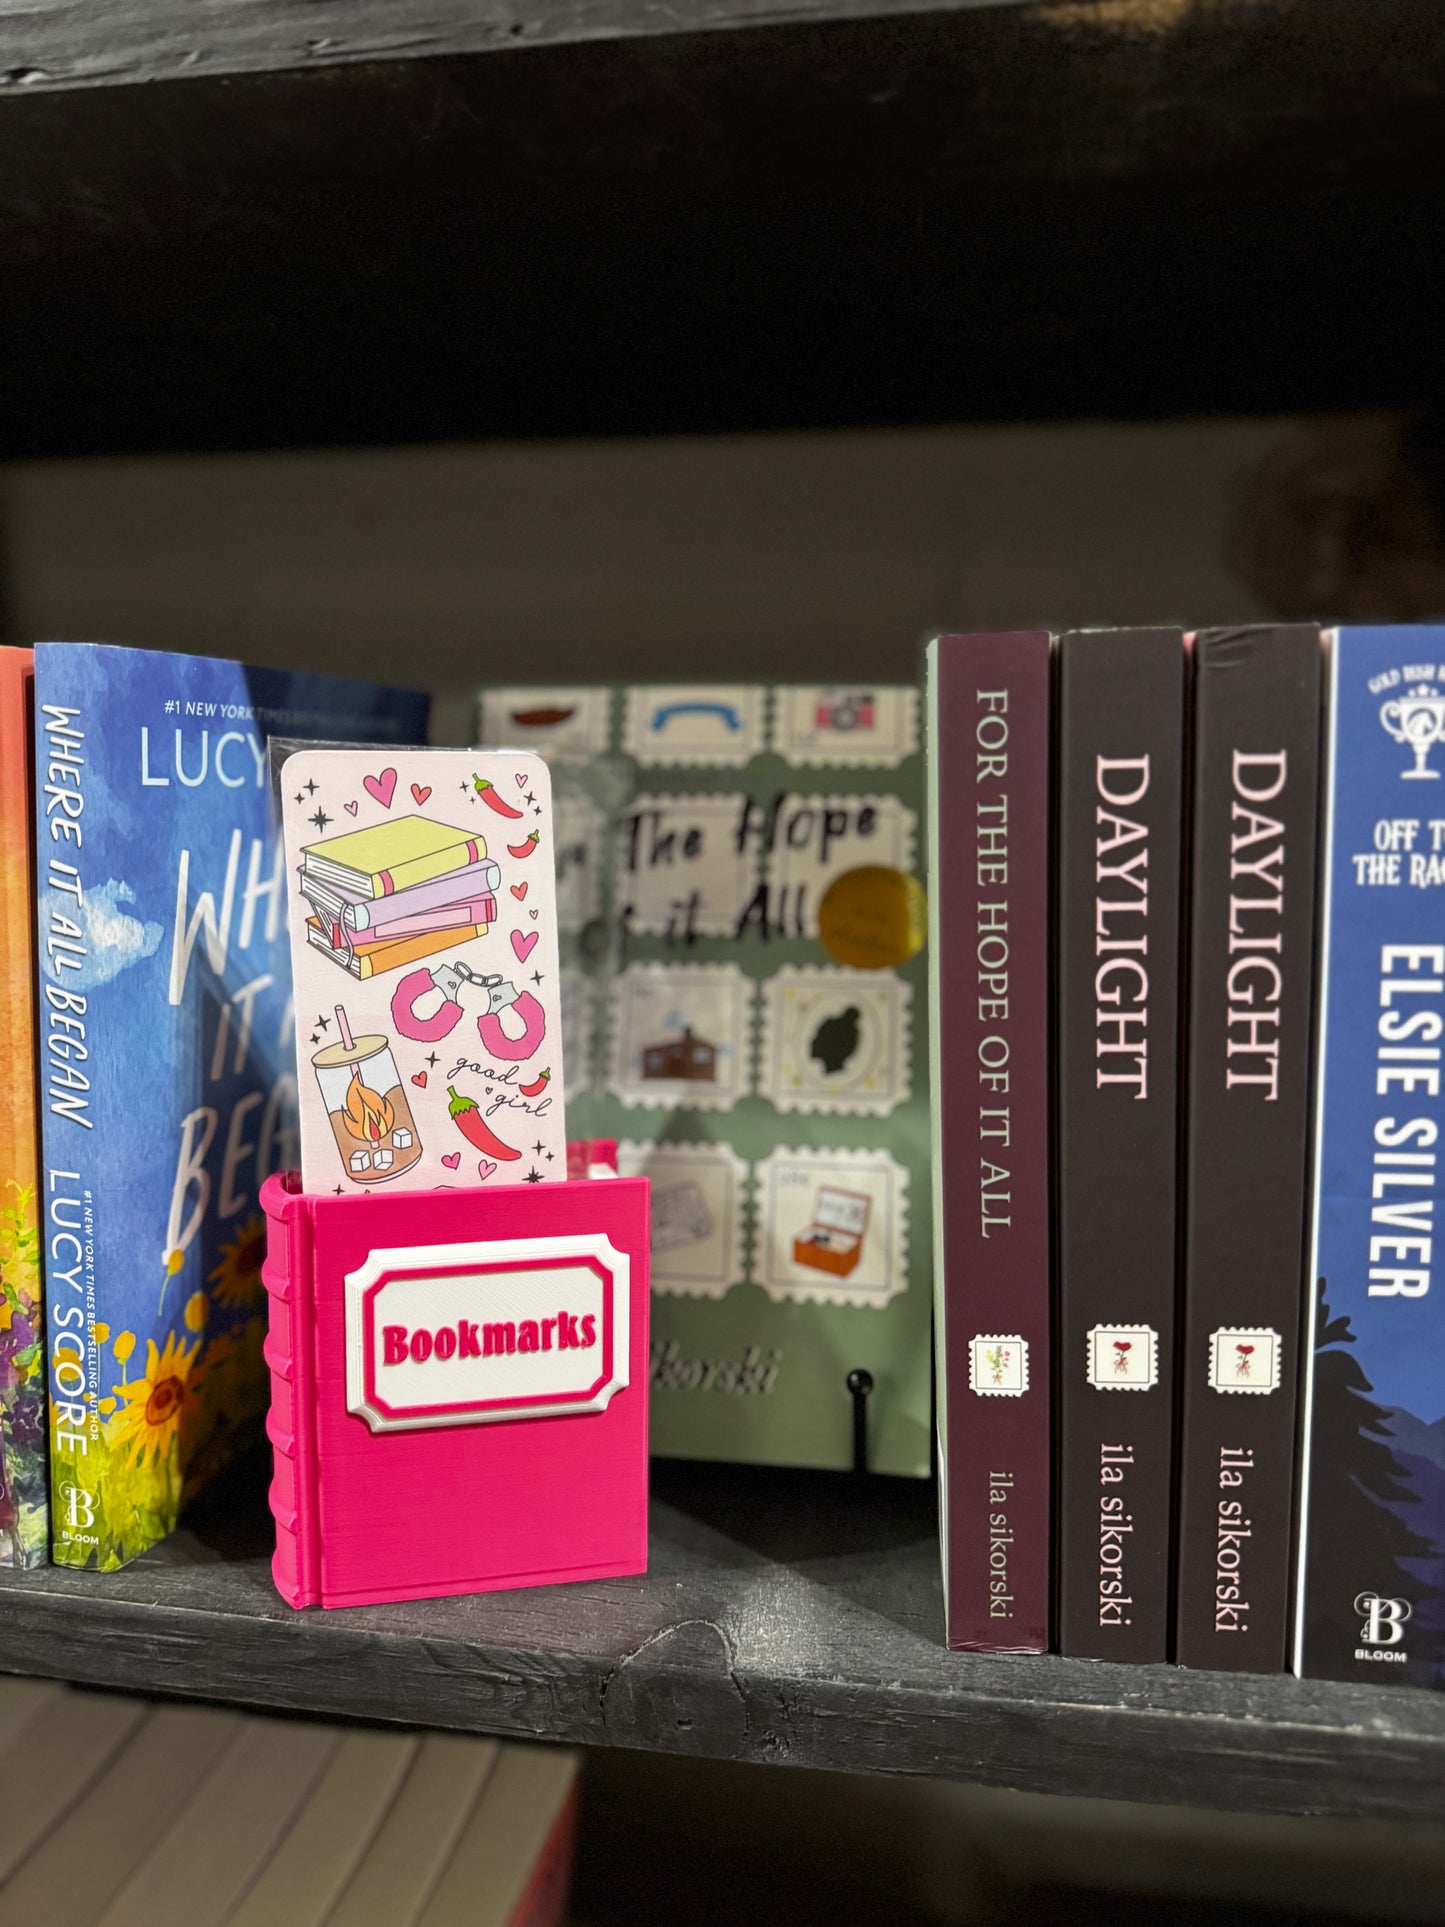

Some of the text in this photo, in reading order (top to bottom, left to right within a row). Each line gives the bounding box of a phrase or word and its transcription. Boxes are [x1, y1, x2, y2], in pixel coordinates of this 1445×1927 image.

[164, 699, 181, 714] #1
[185, 701, 216, 717] NEW
[220, 704, 254, 720] YORK
[141, 727, 268, 788] LUCY
[618, 809, 705, 873] The
[735, 793, 877, 866] Hope
[1374, 819, 1420, 852] OFF
[1352, 853, 1402, 886] THE
[41, 704, 93, 1129] WHERE IT ALL BEGAN
[735, 882, 808, 944] All
[1095, 754, 1151, 1100] DAYLIGHT
[1226, 749, 1287, 1101] DAYLIGHT
[976, 689, 1012, 1239] FOR THE HOPE OF IT ALL
[210, 974, 274, 1081] IT
[447, 1058, 519, 1085] good
[486, 1095, 552, 1117] girl
[1367, 944, 1445, 1298] ELSIE SILVER
[84, 1207, 94, 1236] NEW
[85, 1236, 95, 1271] YORK
[49, 1169, 87, 1456] LUCY SCORE
[86, 1274, 96, 1311] TIMES
[87, 1312, 98, 1388] BESTSELLING
[383, 1310, 596, 1366] Bookmarks
[89, 1392, 99, 1441] AUTHOR
[62, 1532, 99, 1545] BLOOM
[989, 1471, 1014, 1619] ila sikorski
[1099, 1443, 1134, 1626] ila sikorski
[1214, 1446, 1254, 1632] ila sikorski
[1354, 1649, 1407, 1662] BLOOM
